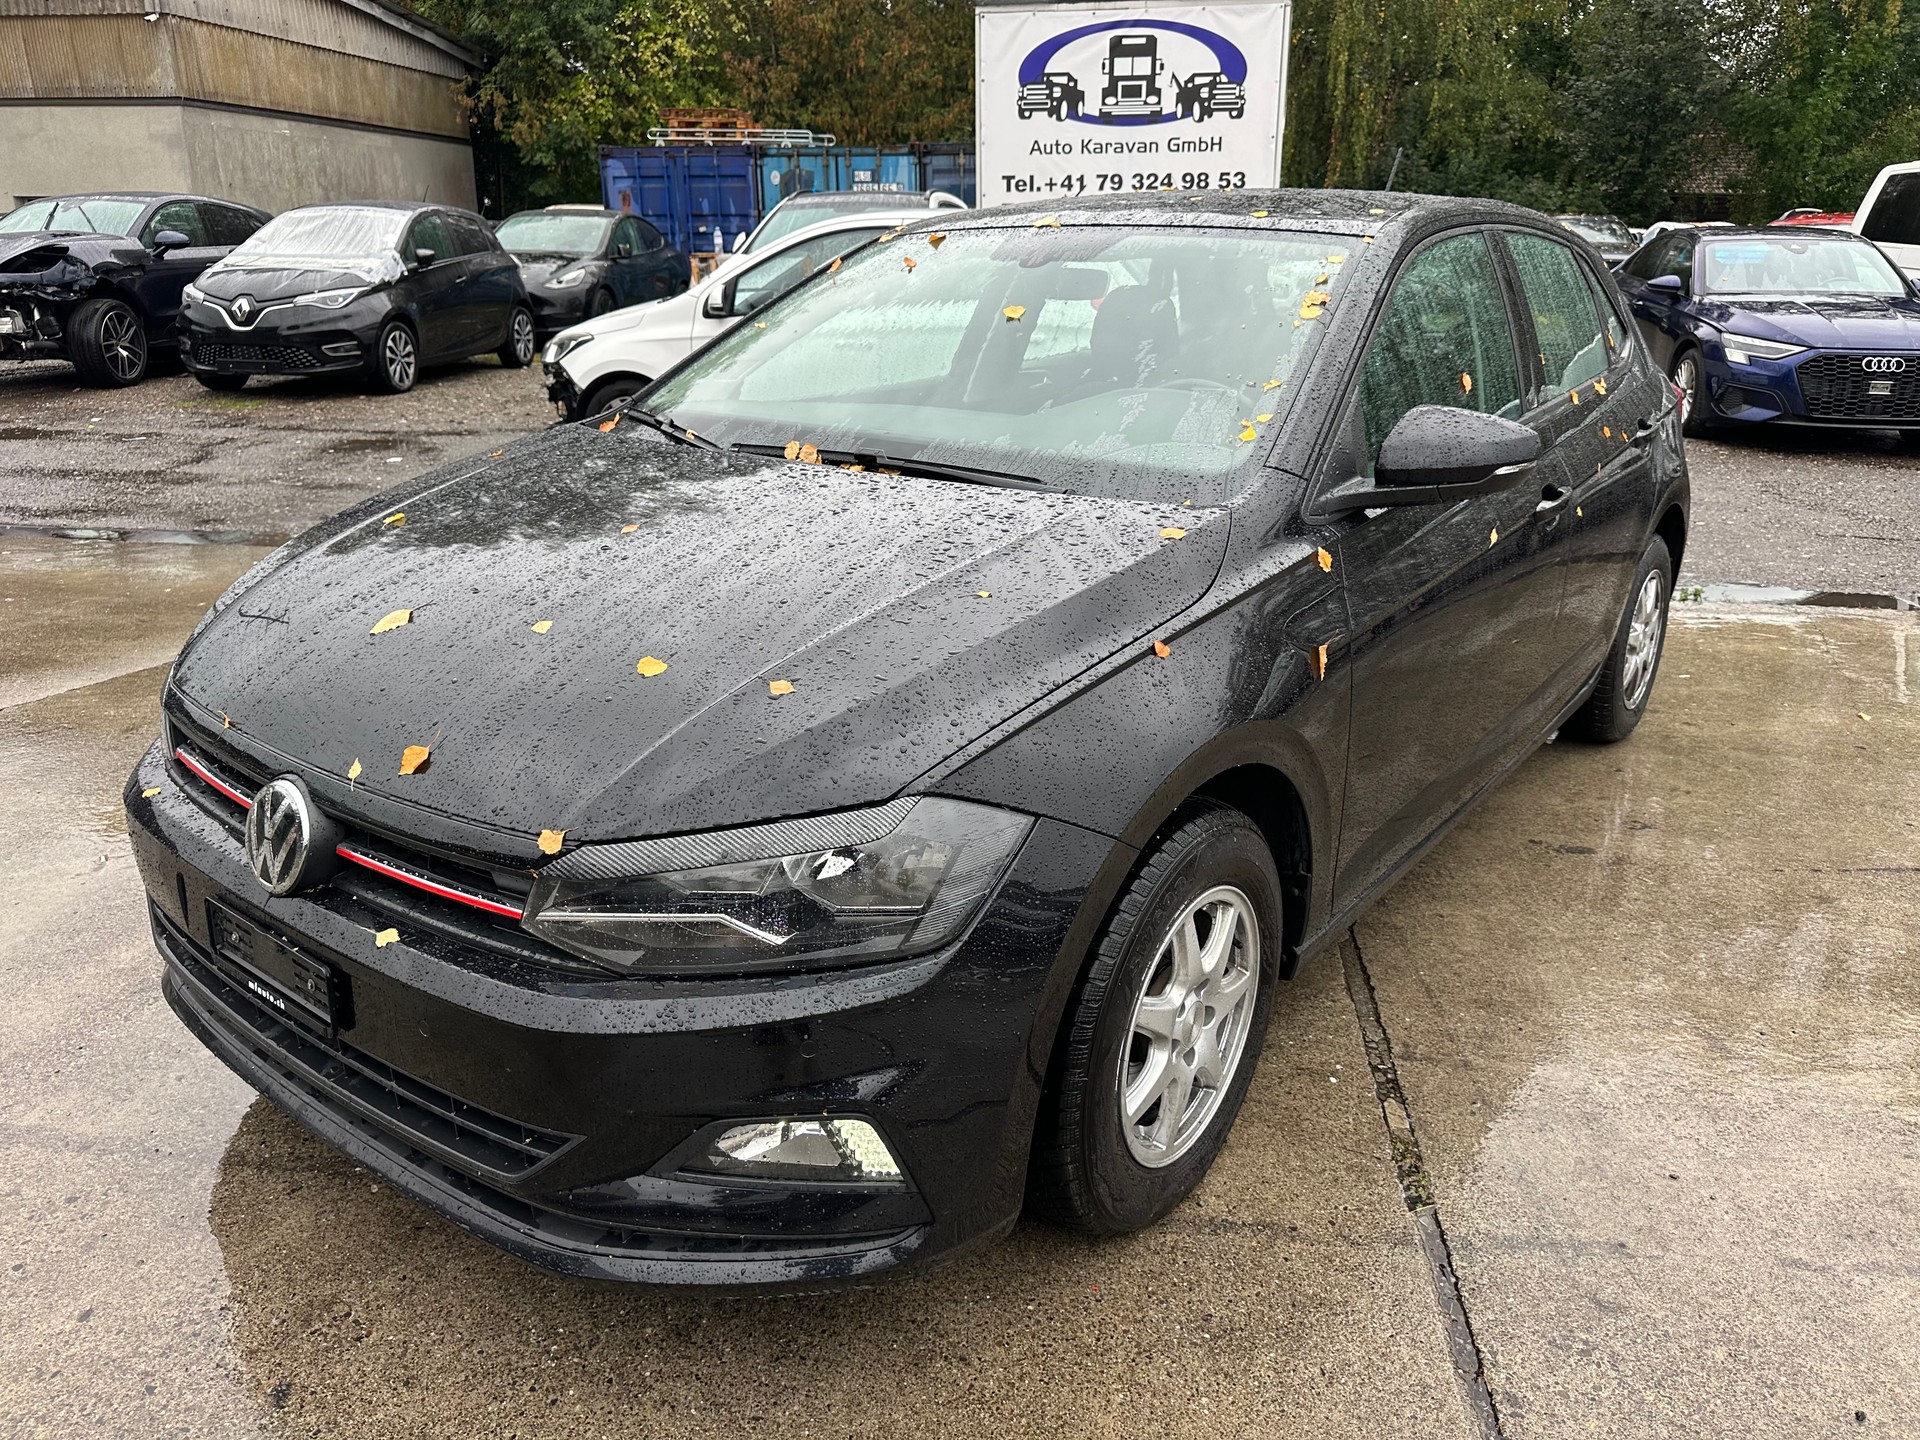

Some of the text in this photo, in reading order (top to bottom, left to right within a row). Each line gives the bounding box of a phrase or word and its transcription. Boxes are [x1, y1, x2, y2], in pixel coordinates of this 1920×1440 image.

[1029, 136, 1222, 155] Auto Karavan GmbH
[1096, 174, 1123, 191] 79
[1131, 173, 1173, 191] 324
[1181, 172, 1210, 190] 98
[1217, 171, 1246, 189] 53
